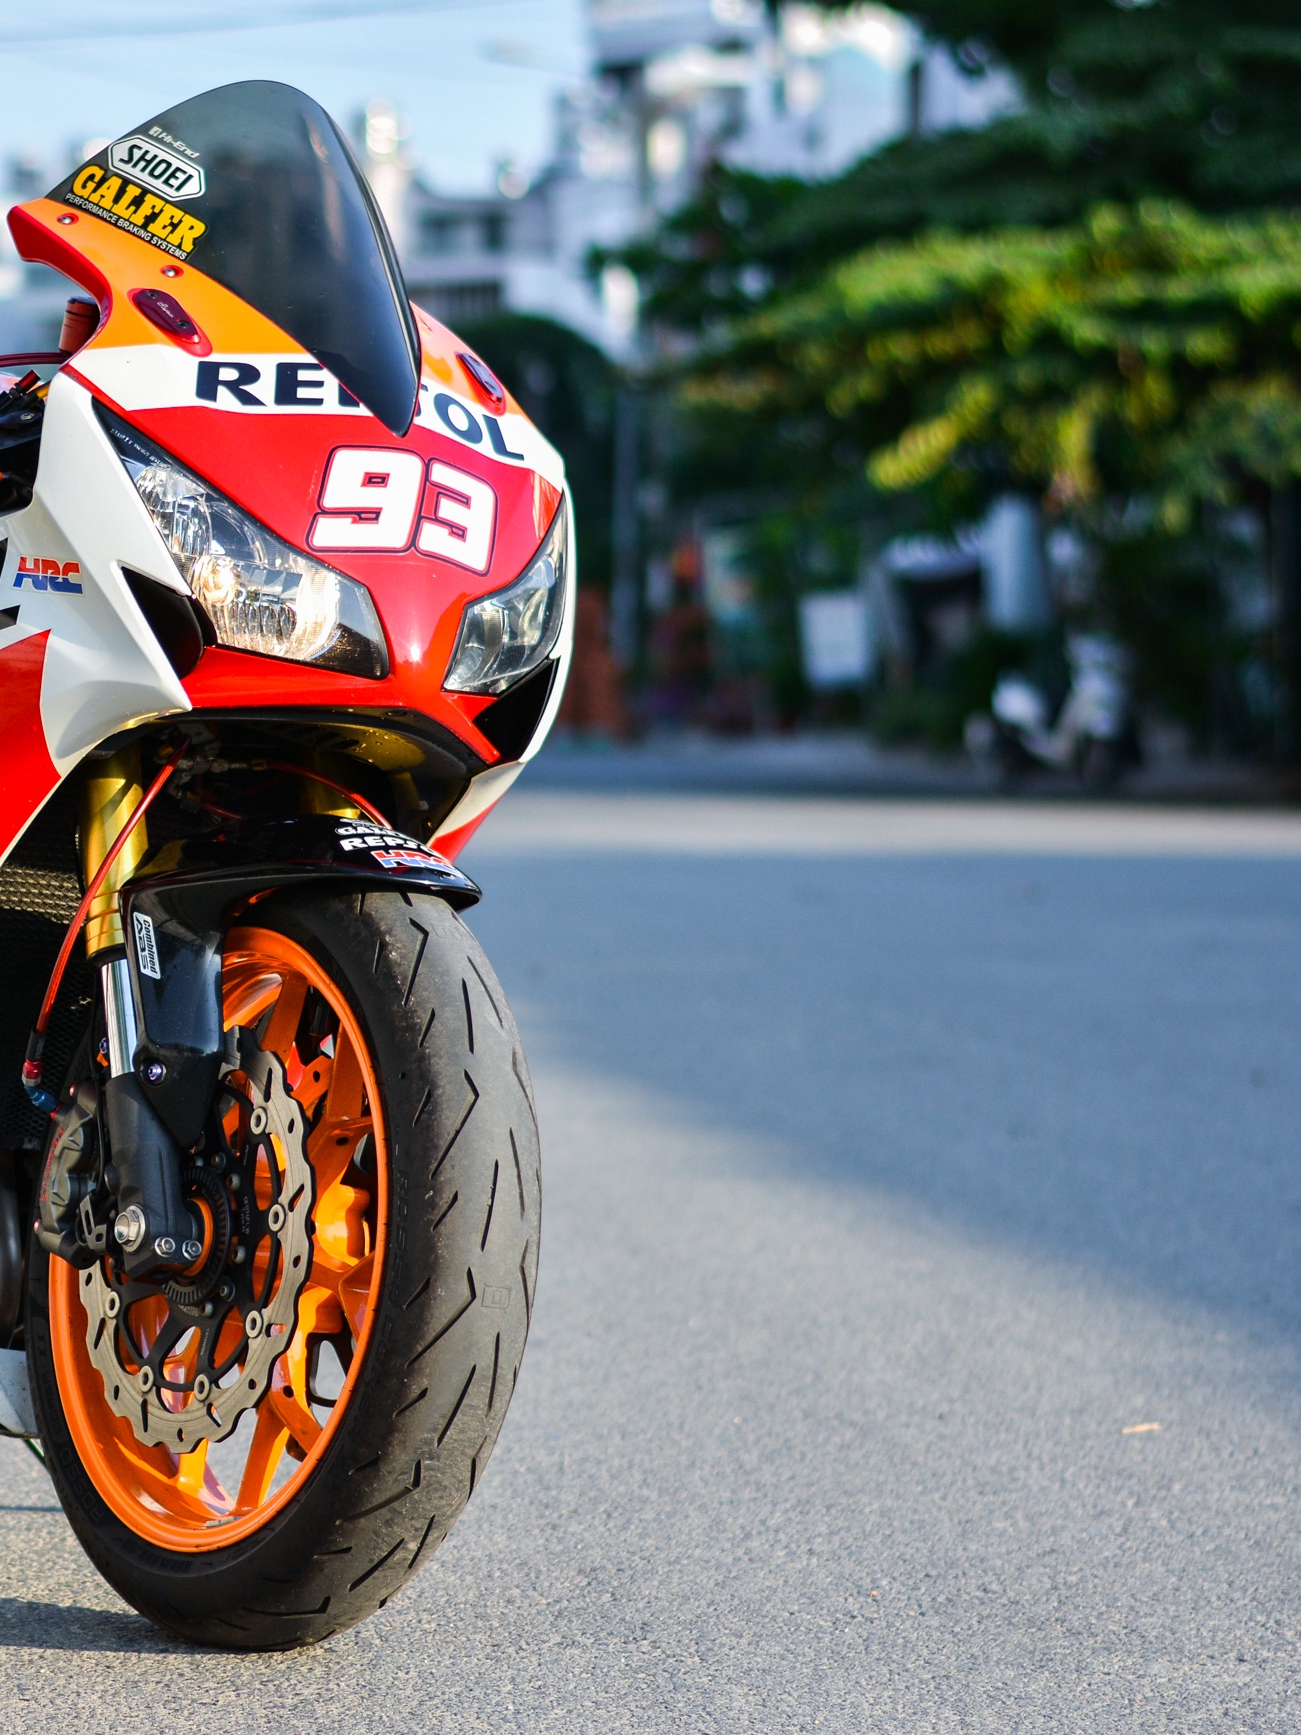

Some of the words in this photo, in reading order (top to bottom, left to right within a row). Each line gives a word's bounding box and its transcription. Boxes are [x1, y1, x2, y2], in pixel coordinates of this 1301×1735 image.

[118, 144, 194, 193] SHOEI
[65, 193, 119, 224] PERFORMANCE
[117, 218, 152, 241] BRAKING
[151, 236, 188, 260] SYSTEMS
[72, 165, 206, 253] GALFER
[305, 444, 498, 577] 93
[12, 556, 84, 594] HRC
[135, 915, 149, 970] ABS
